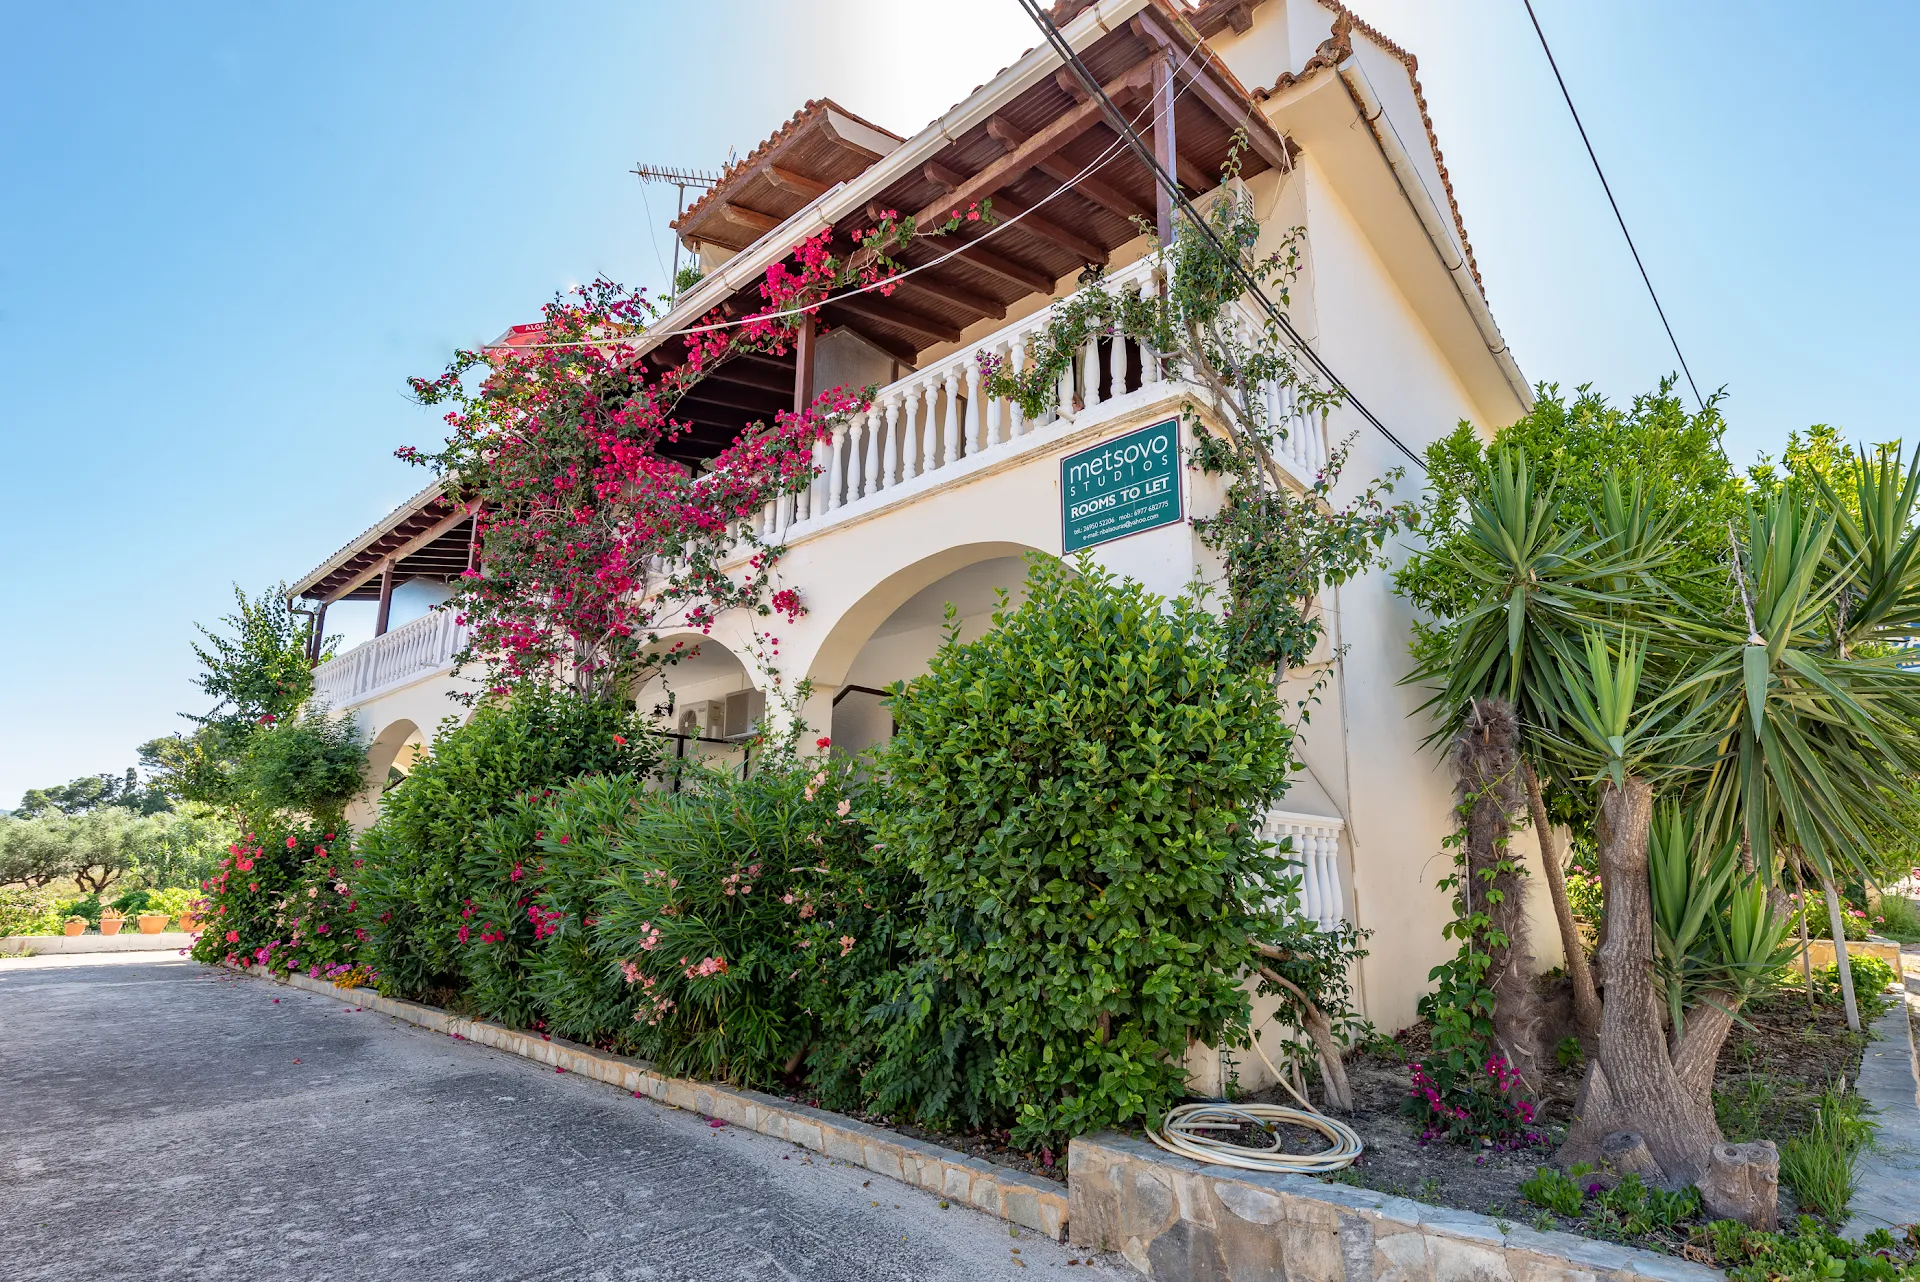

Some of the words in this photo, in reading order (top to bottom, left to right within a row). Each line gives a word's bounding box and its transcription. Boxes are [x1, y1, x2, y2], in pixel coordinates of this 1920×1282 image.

[1070, 435, 1168, 484] metsovo
[1070, 454, 1168, 497] STUDIOS
[1071, 494, 1116, 518] ROOMS
[1120, 487, 1140, 502] TO
[1145, 477, 1170, 494] LET
[1083, 522, 1098, 532] 26950
[1099, 517, 1115, 527] 52206
[1118, 512, 1133, 521] mob.:
[1134, 507, 1147, 517] 6977
[1148, 500, 1169, 512] 682775
